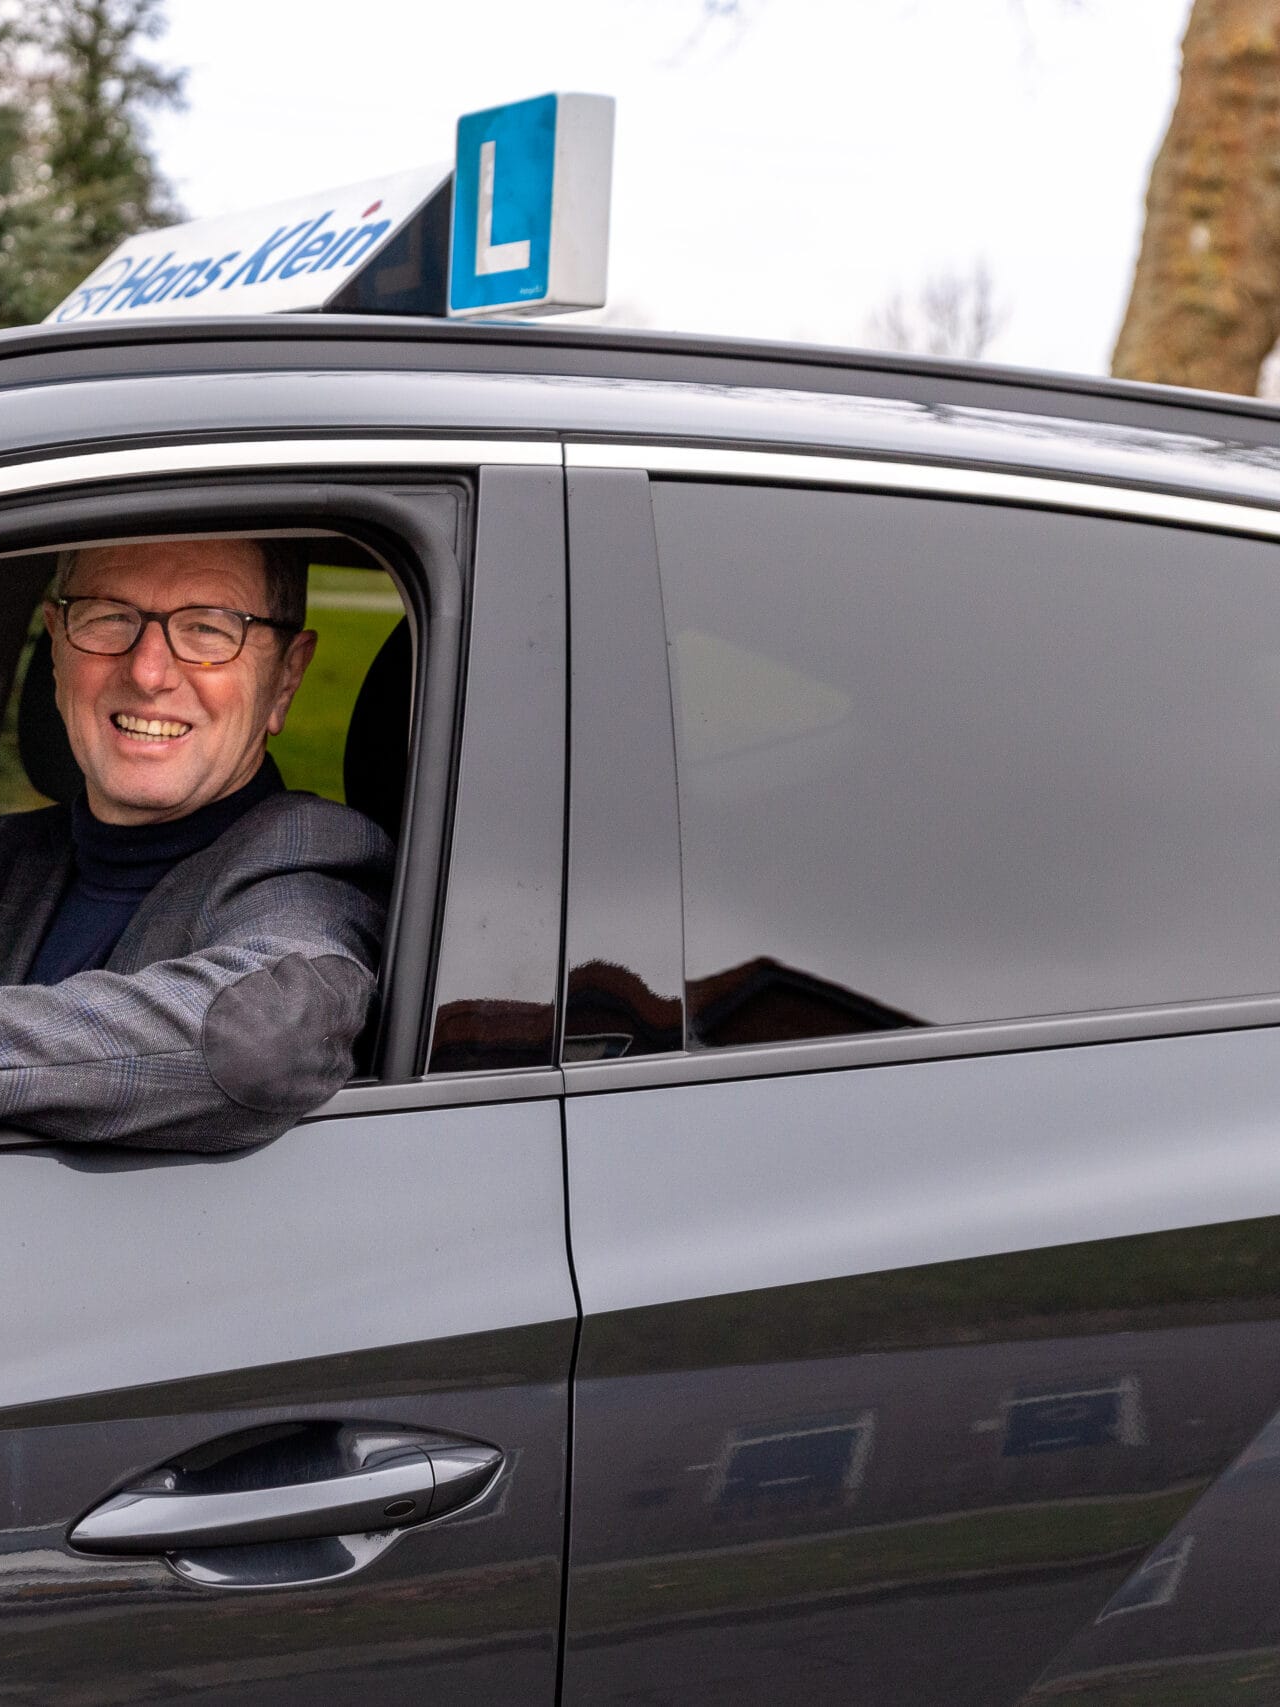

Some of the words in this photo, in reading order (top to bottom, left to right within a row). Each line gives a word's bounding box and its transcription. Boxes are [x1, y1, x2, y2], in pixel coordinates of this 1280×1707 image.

[94, 251, 242, 315] Hans
[220, 200, 392, 290] Klein
[475, 140, 531, 276] L
